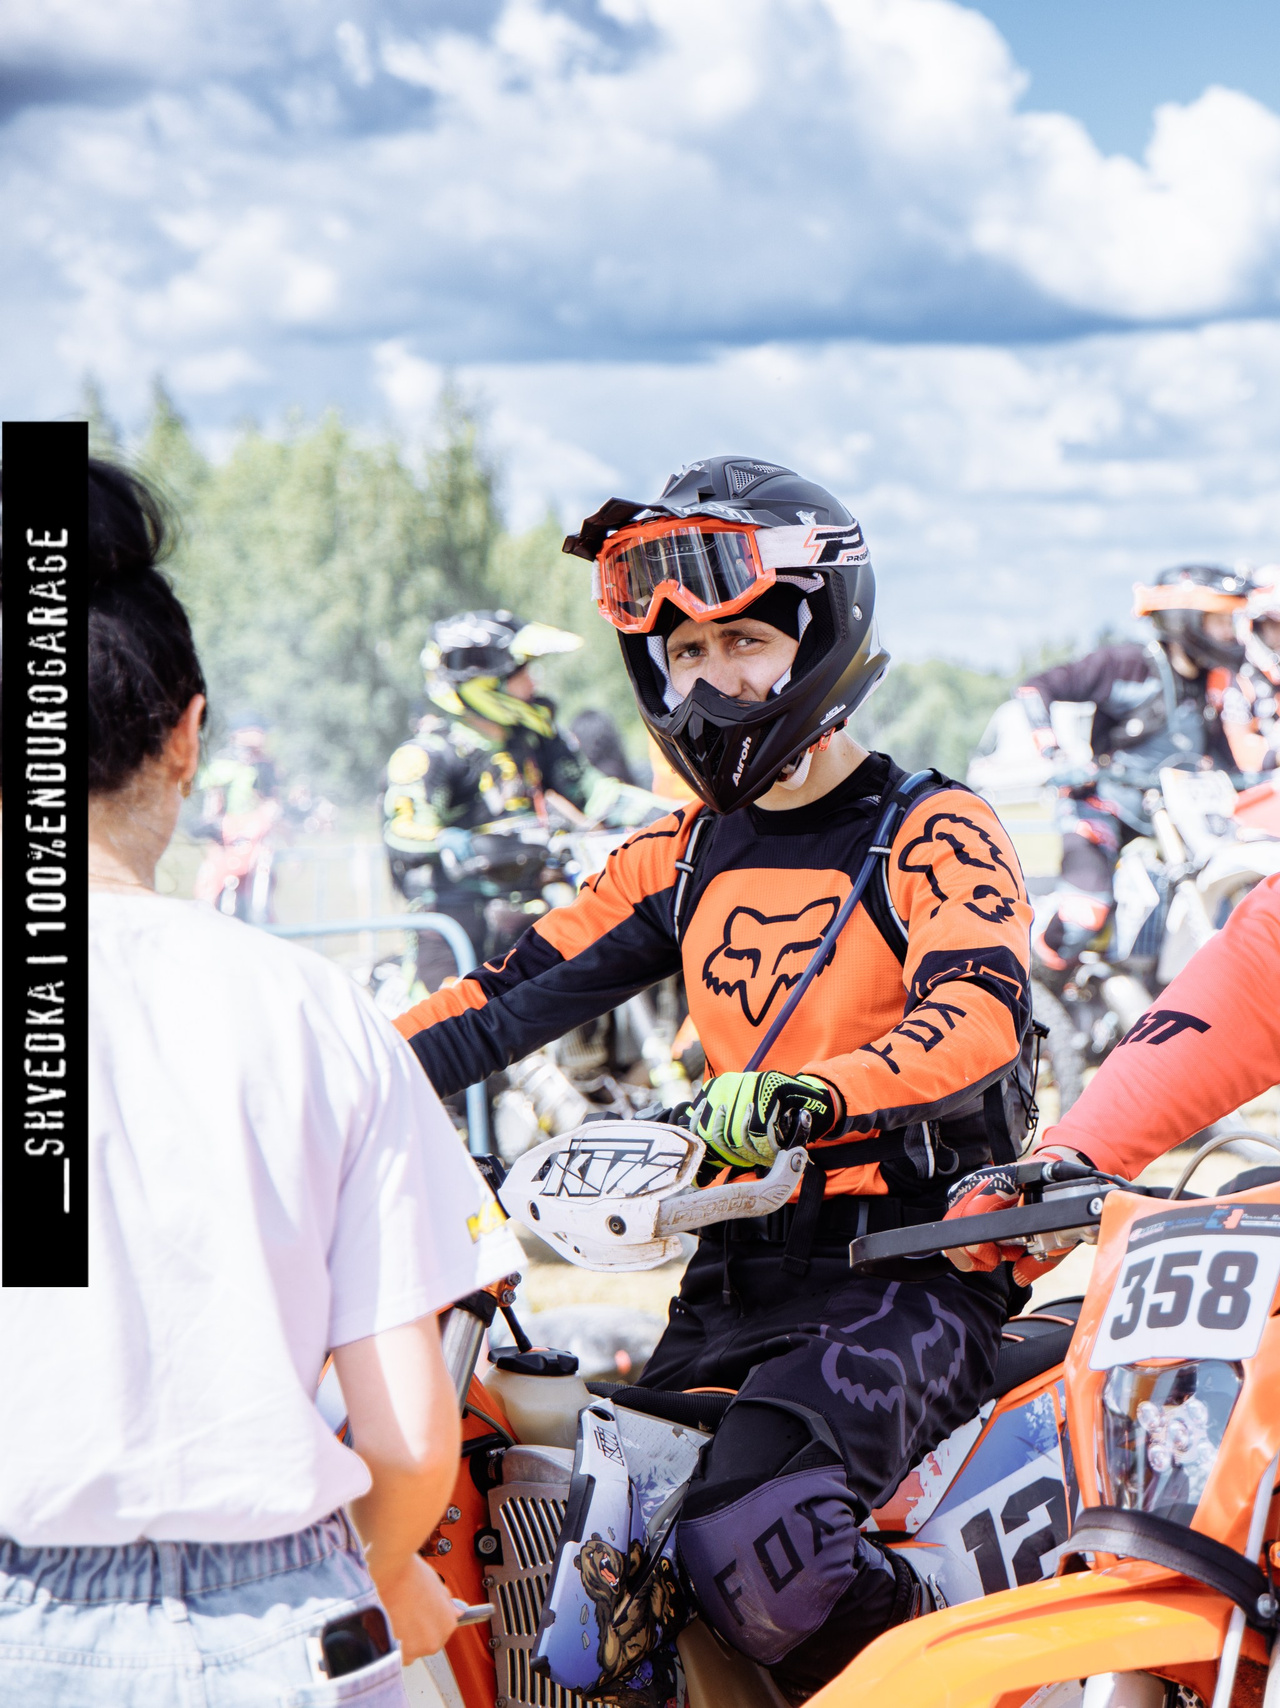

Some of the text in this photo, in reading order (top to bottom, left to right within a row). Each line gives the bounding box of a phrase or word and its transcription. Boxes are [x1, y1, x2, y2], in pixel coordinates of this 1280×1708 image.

[732, 736, 752, 788] Airoh
[803, 1097, 828, 1115] UFO
[1110, 1250, 1259, 1341] 358
[712, 1495, 836, 1628] FOX
